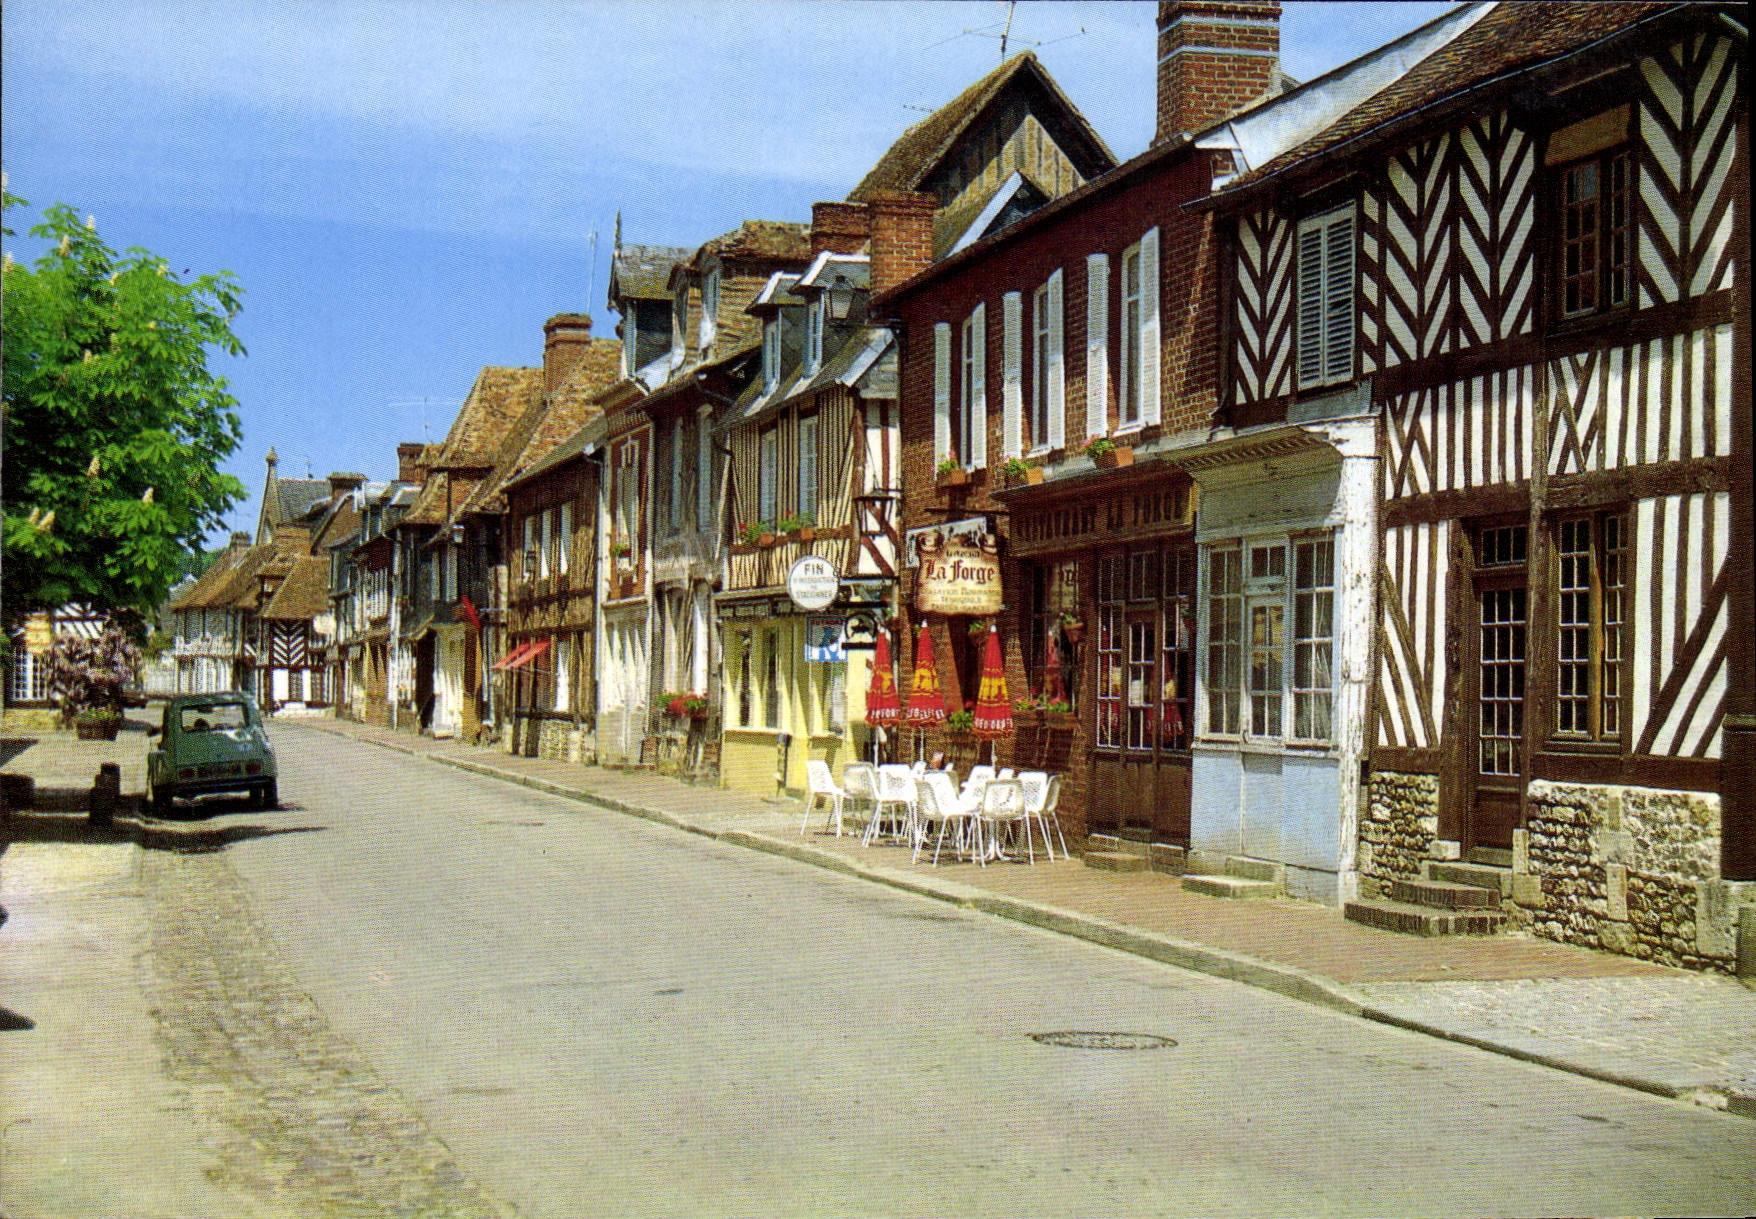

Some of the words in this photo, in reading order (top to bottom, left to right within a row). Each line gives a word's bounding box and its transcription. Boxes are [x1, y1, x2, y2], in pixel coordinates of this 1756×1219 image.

[804, 563, 824, 575] FIN
[924, 559, 947, 580] La
[947, 558, 996, 585] Forge
